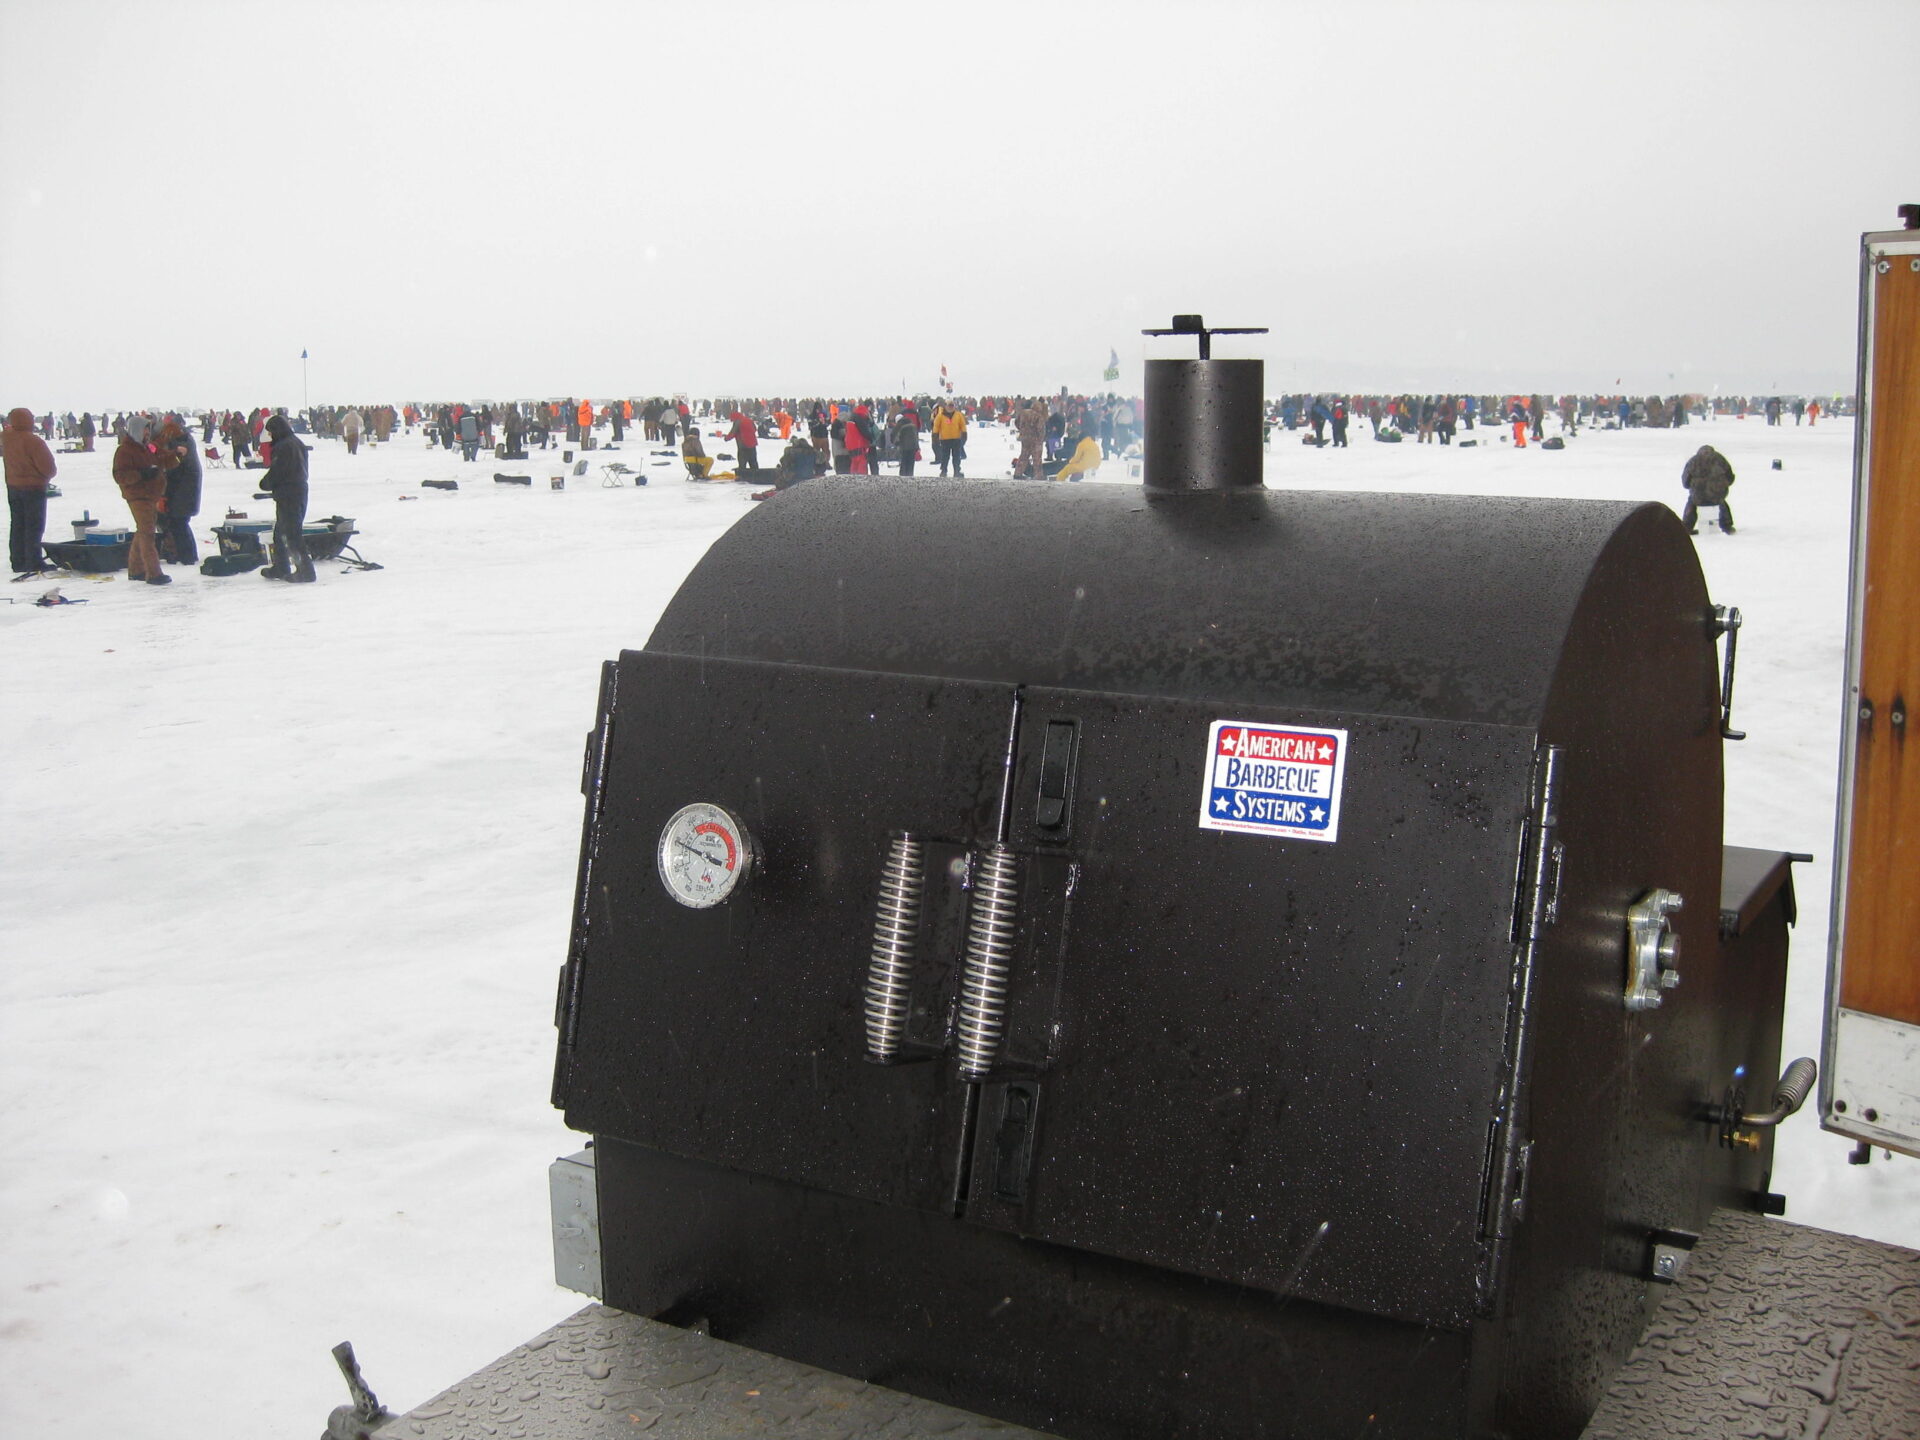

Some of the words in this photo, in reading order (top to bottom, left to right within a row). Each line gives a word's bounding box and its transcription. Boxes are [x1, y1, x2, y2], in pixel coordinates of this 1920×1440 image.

[1234, 727, 1316, 761] AMERICAN
[1225, 757, 1320, 793] BARBECUE
[1232, 790, 1307, 823] SYSTEMS
